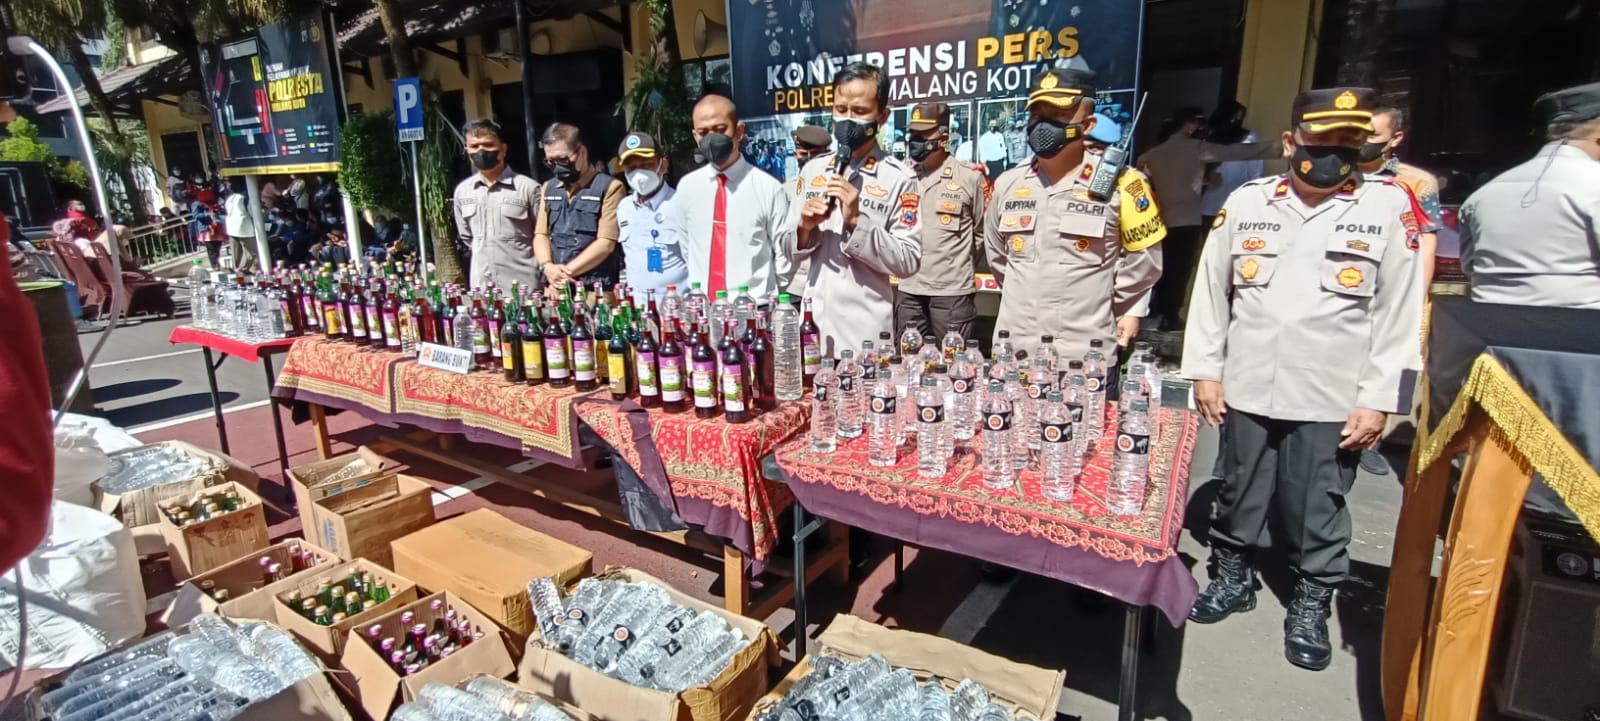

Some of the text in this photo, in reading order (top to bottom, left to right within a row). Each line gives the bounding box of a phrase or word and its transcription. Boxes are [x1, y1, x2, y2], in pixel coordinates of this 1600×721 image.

[977, 26, 1080, 68] PERS
[398, 83, 418, 124] P
[859, 197, 889, 214] OLRI
[1004, 199, 1037, 210] SUPIYAN
[1066, 202, 1105, 215] POLRI
[1237, 222, 1282, 232] SUYOTO
[1335, 223, 1383, 236] POLRI
